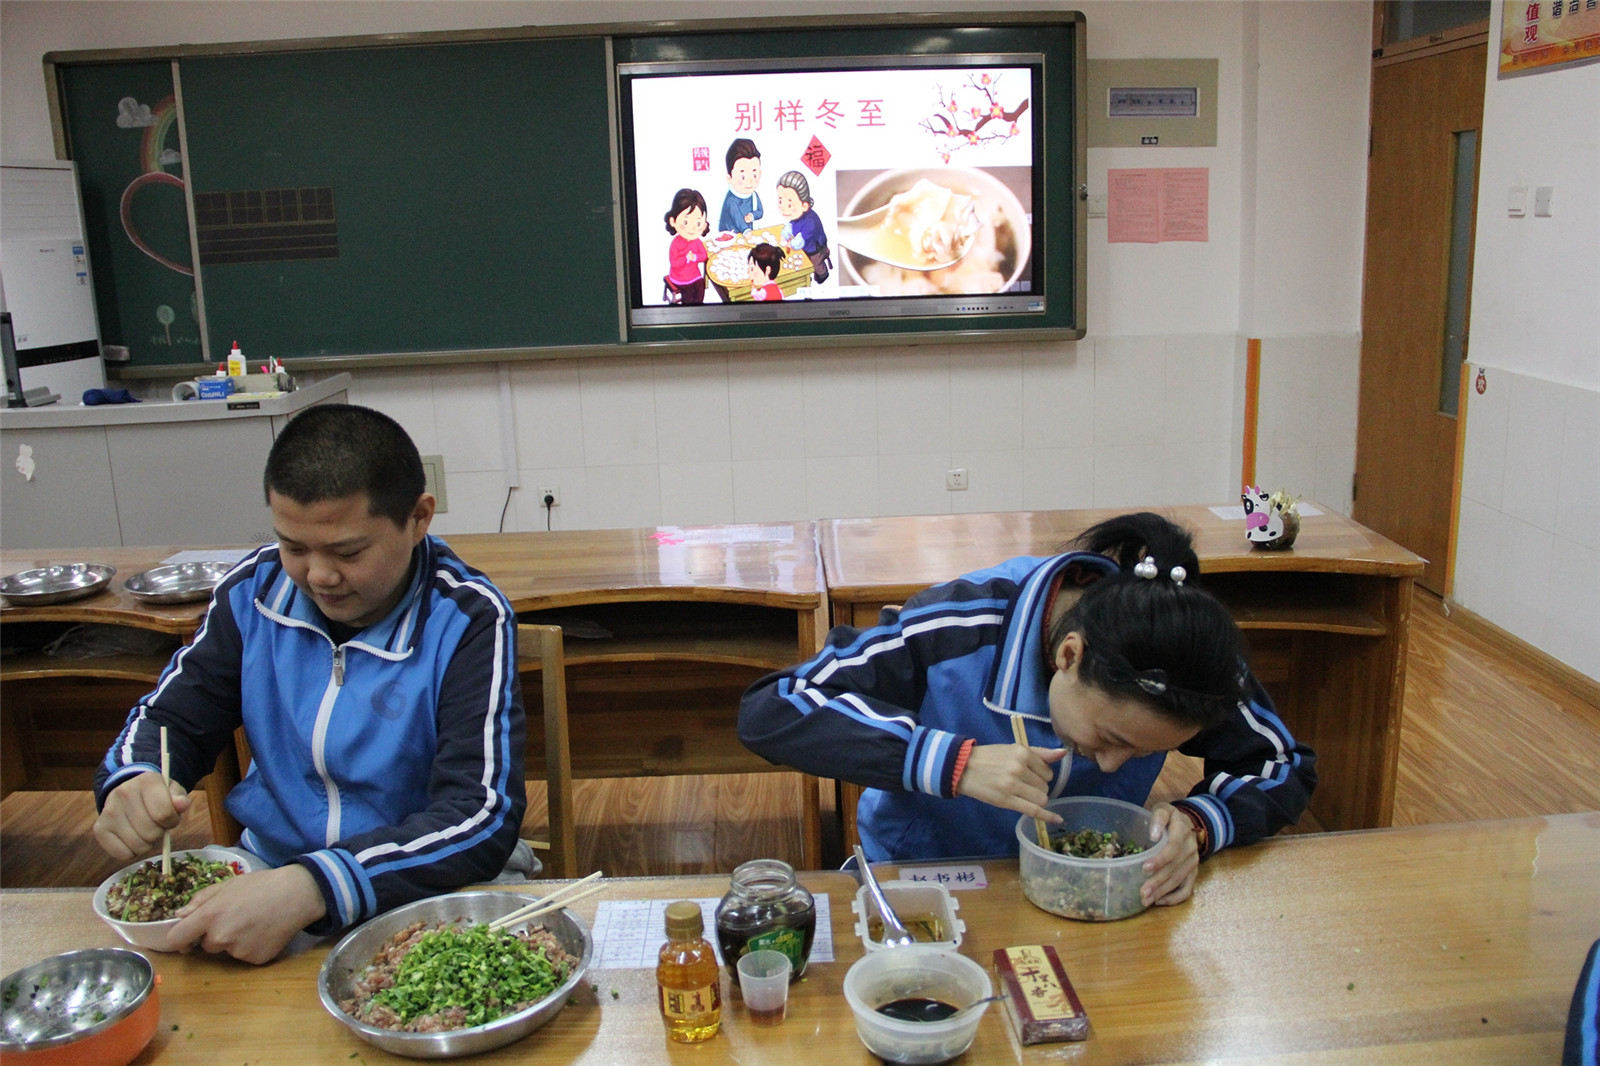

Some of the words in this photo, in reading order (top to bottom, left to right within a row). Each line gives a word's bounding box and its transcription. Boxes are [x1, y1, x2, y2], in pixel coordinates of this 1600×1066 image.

[1524, 3, 1540, 42] 值观
[735, 99, 886, 132] 别样冬至
[805, 144, 825, 169] 福
